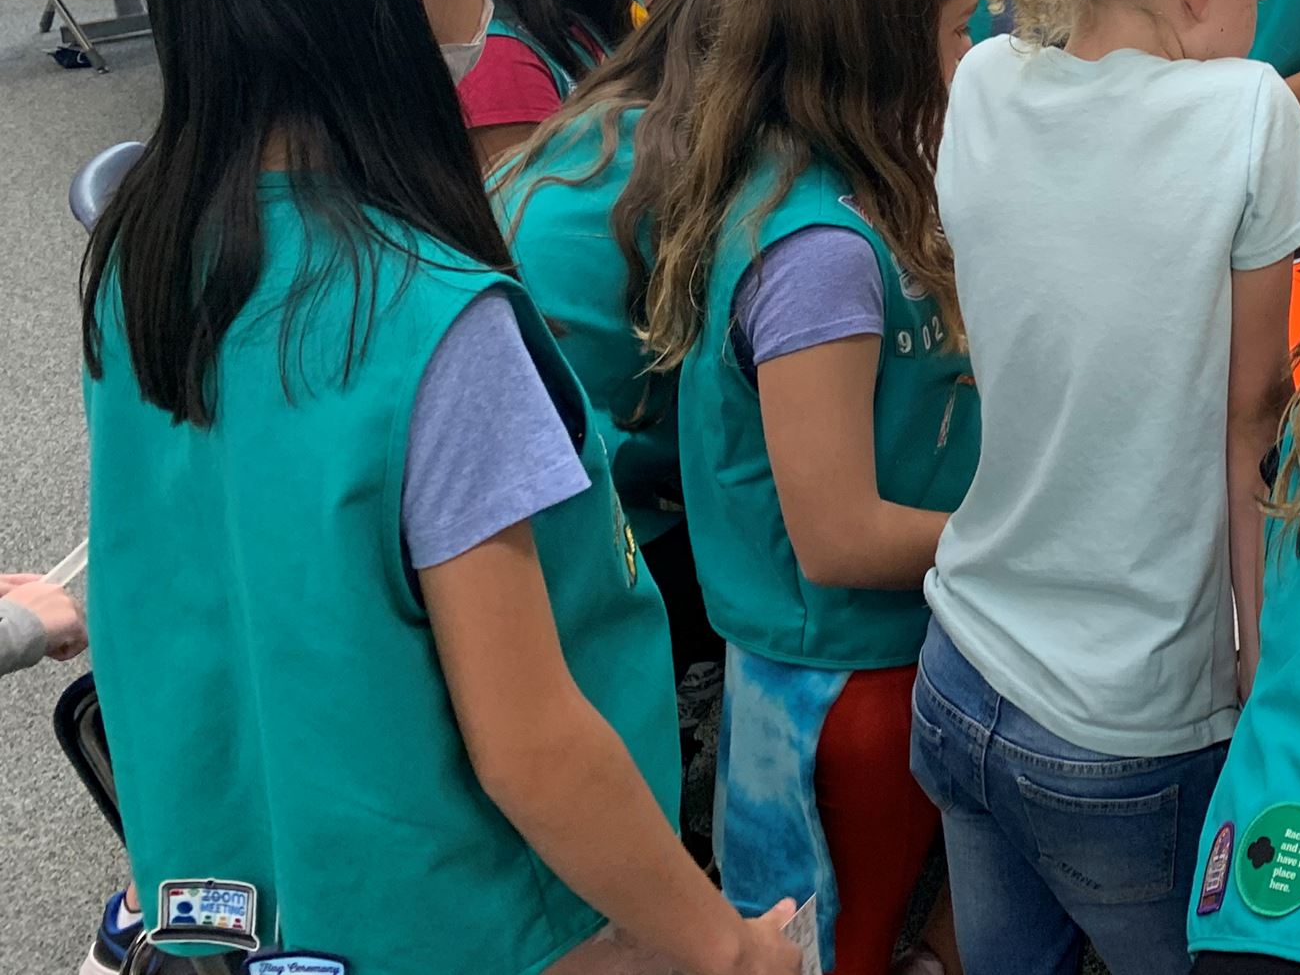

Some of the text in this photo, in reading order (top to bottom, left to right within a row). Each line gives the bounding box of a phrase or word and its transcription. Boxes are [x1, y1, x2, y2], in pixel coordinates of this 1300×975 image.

[1280, 842, 1299, 853] and
[1276, 852, 1298, 867] have
[1272, 866, 1297, 881] place
[1269, 878, 1291, 893] here.
[200, 903, 246, 917] MEETING
[287, 962, 340, 975] Ceremony
